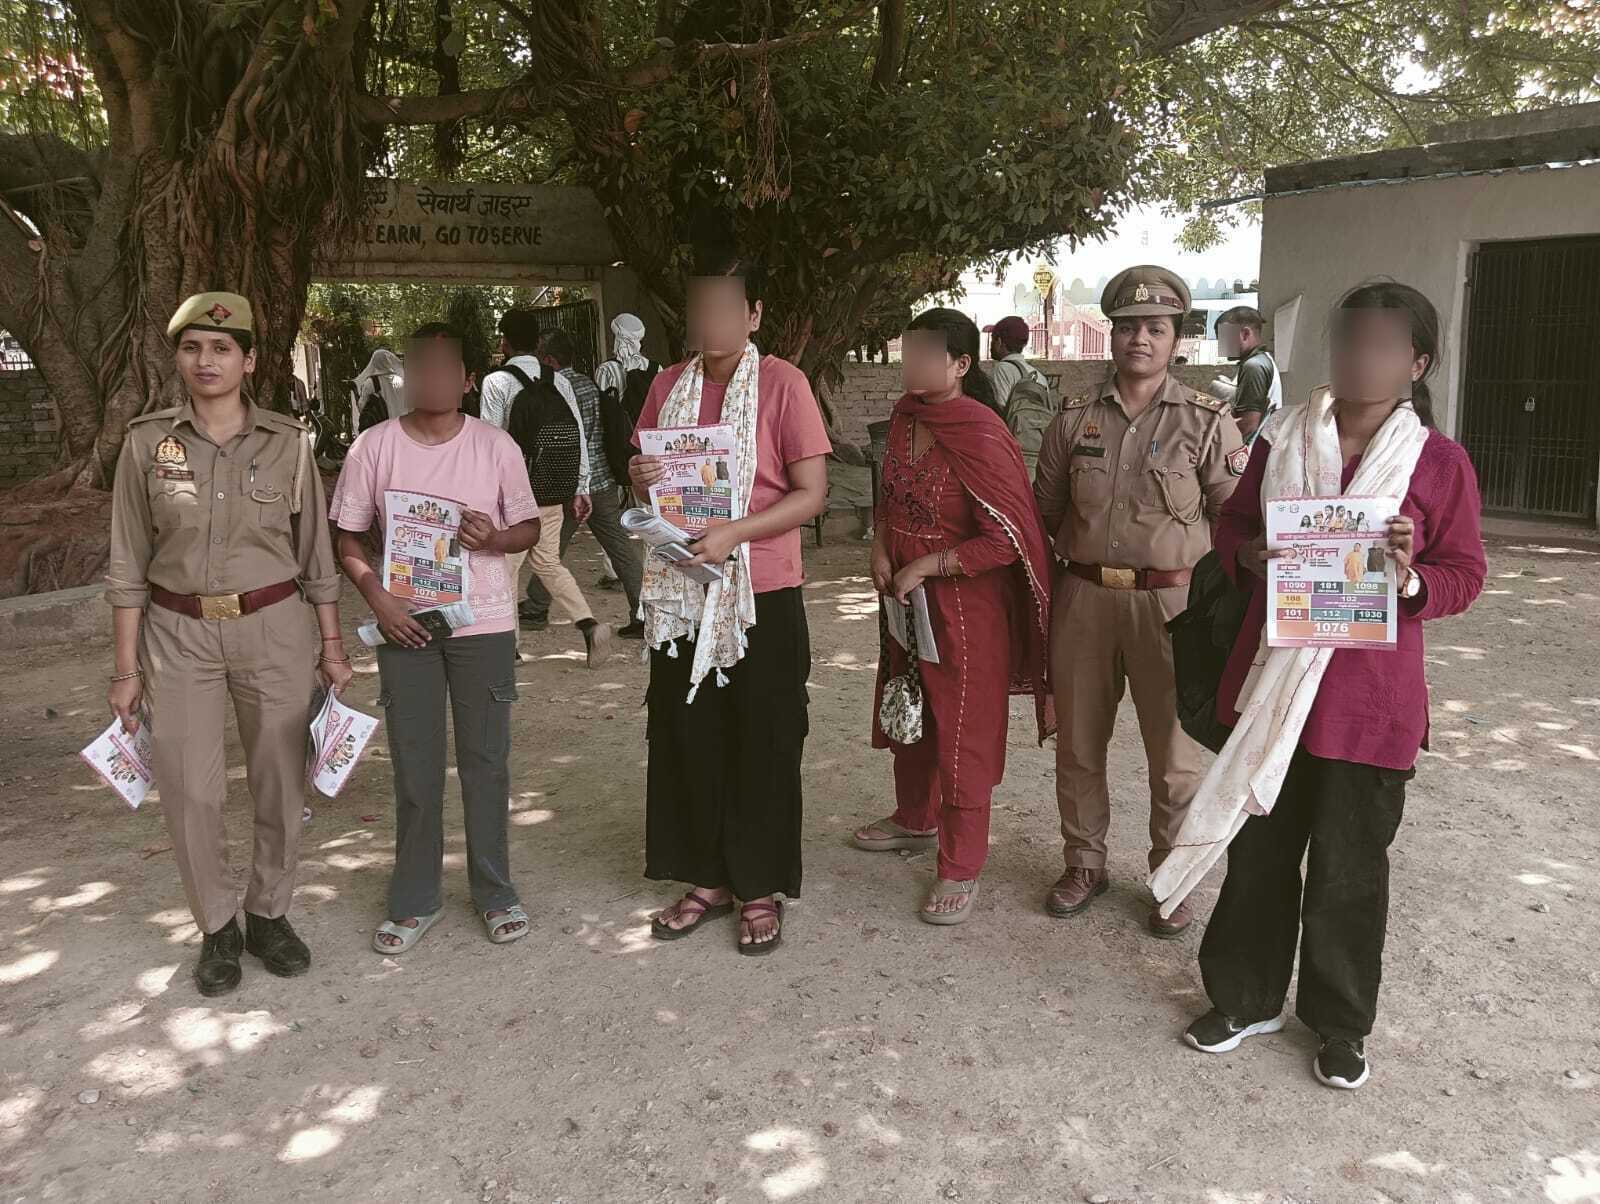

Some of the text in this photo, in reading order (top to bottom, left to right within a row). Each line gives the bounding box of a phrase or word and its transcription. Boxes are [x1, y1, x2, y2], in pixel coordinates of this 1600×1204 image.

[416, 186, 475, 215] सेवार्थ
[365, 225, 543, 250] LEARN, GO TO SERVE
[1284, 609, 1303, 617] 101
[1314, 622, 1350, 633] 1076
